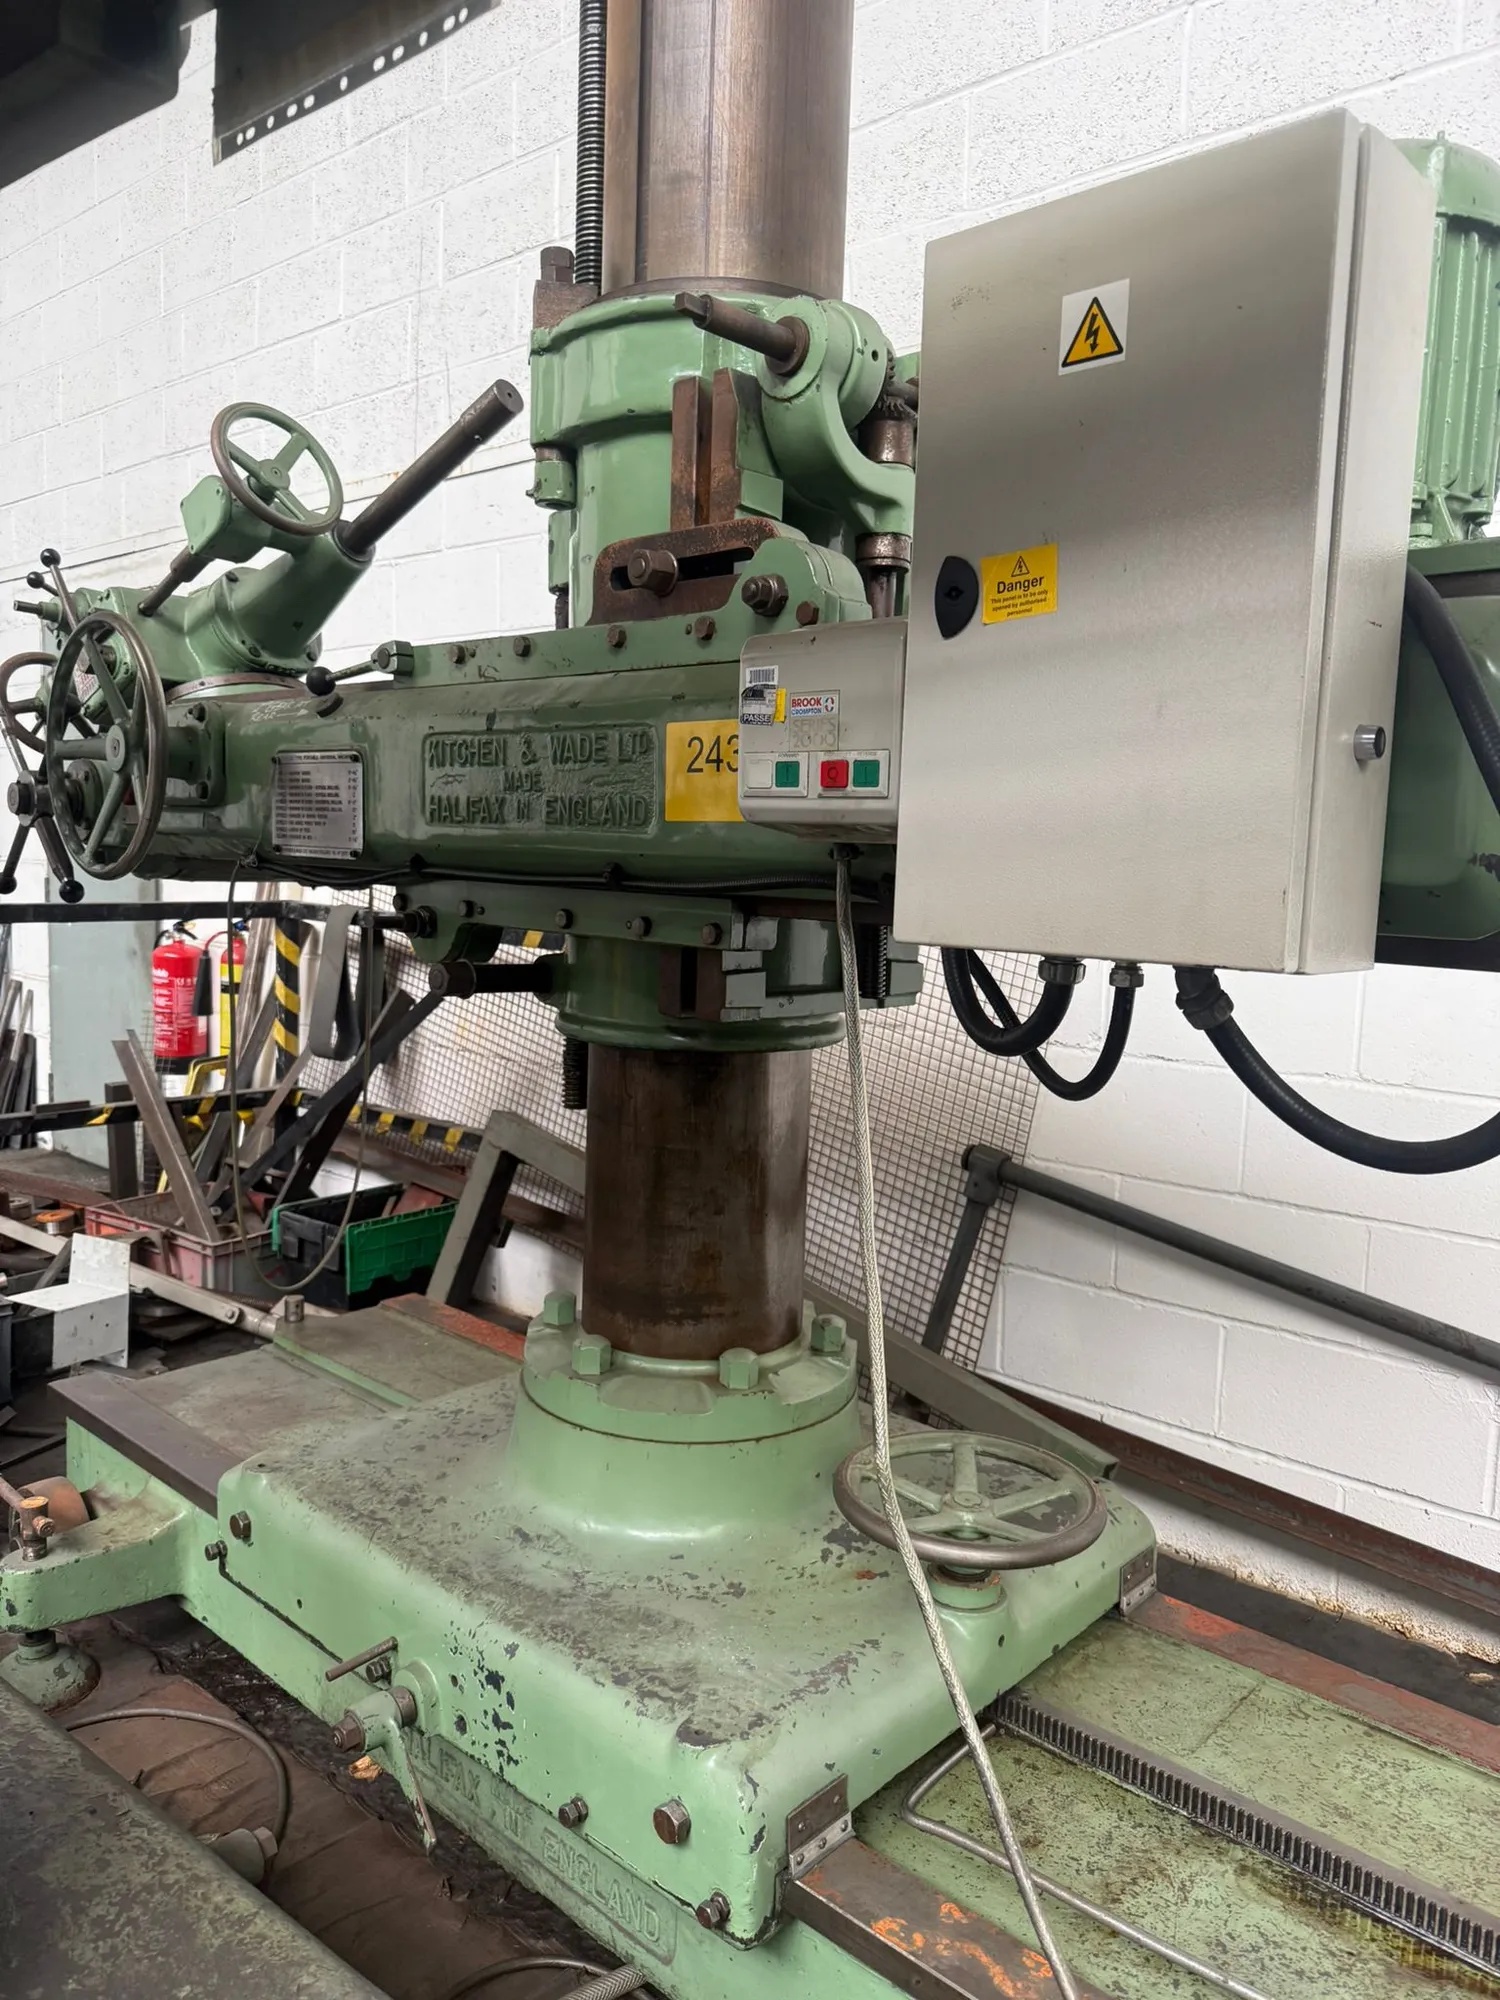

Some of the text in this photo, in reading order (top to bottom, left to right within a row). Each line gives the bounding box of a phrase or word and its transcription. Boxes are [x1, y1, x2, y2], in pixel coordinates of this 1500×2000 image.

[997, 576, 1045, 594] Danger
[1003, 594, 1017, 603] panel
[992, 603, 1011, 612] opened
[1006, 607, 1033, 617] personnel
[792, 697, 822, 708] BROOK
[791, 707, 822, 716] CROMPTON
[792, 717, 836, 733] SERIES
[792, 731, 837, 748] 2000
[429, 730, 648, 768] KITCHEN & WADE LTD
[687, 734, 739, 773] 243
[502, 770, 543, 793] MADE
[429, 795, 506, 825] HALIFAX
[543, 793, 648, 827] ENGLAND
[541, 1826, 660, 1943] ENGLAND
